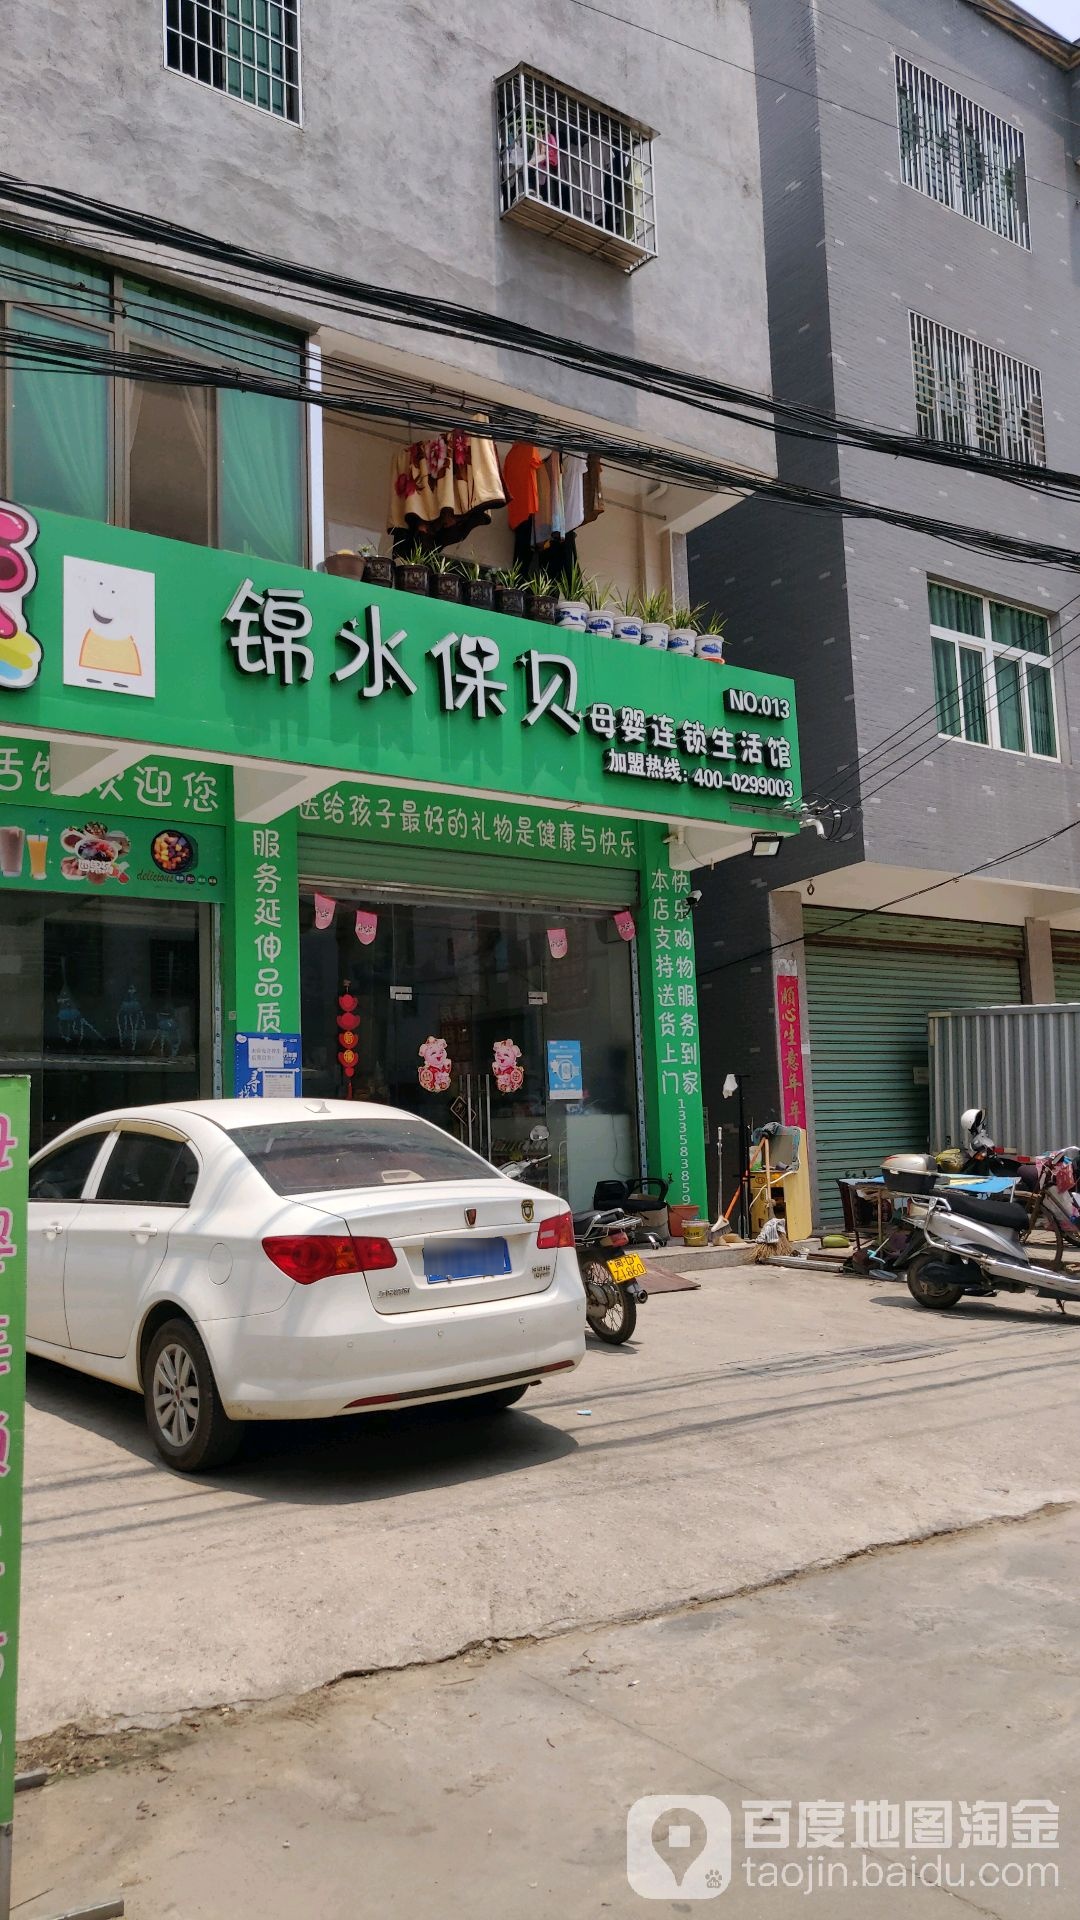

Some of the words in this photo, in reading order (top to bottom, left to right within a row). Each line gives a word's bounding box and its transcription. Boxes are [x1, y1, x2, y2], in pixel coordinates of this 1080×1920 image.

[590, 703, 792, 769] 母婴连锁生活馆
[728, 688, 791, 720] NO.013
[299, 791, 637, 858] 送给孩子最好的礼物是健康与快乐
[253, 828, 283, 1033] 服务延伸品质
[652, 869, 679, 1095] 本店支持送货上门
[672, 871, 699, 1095] 快乐购物服务到家
